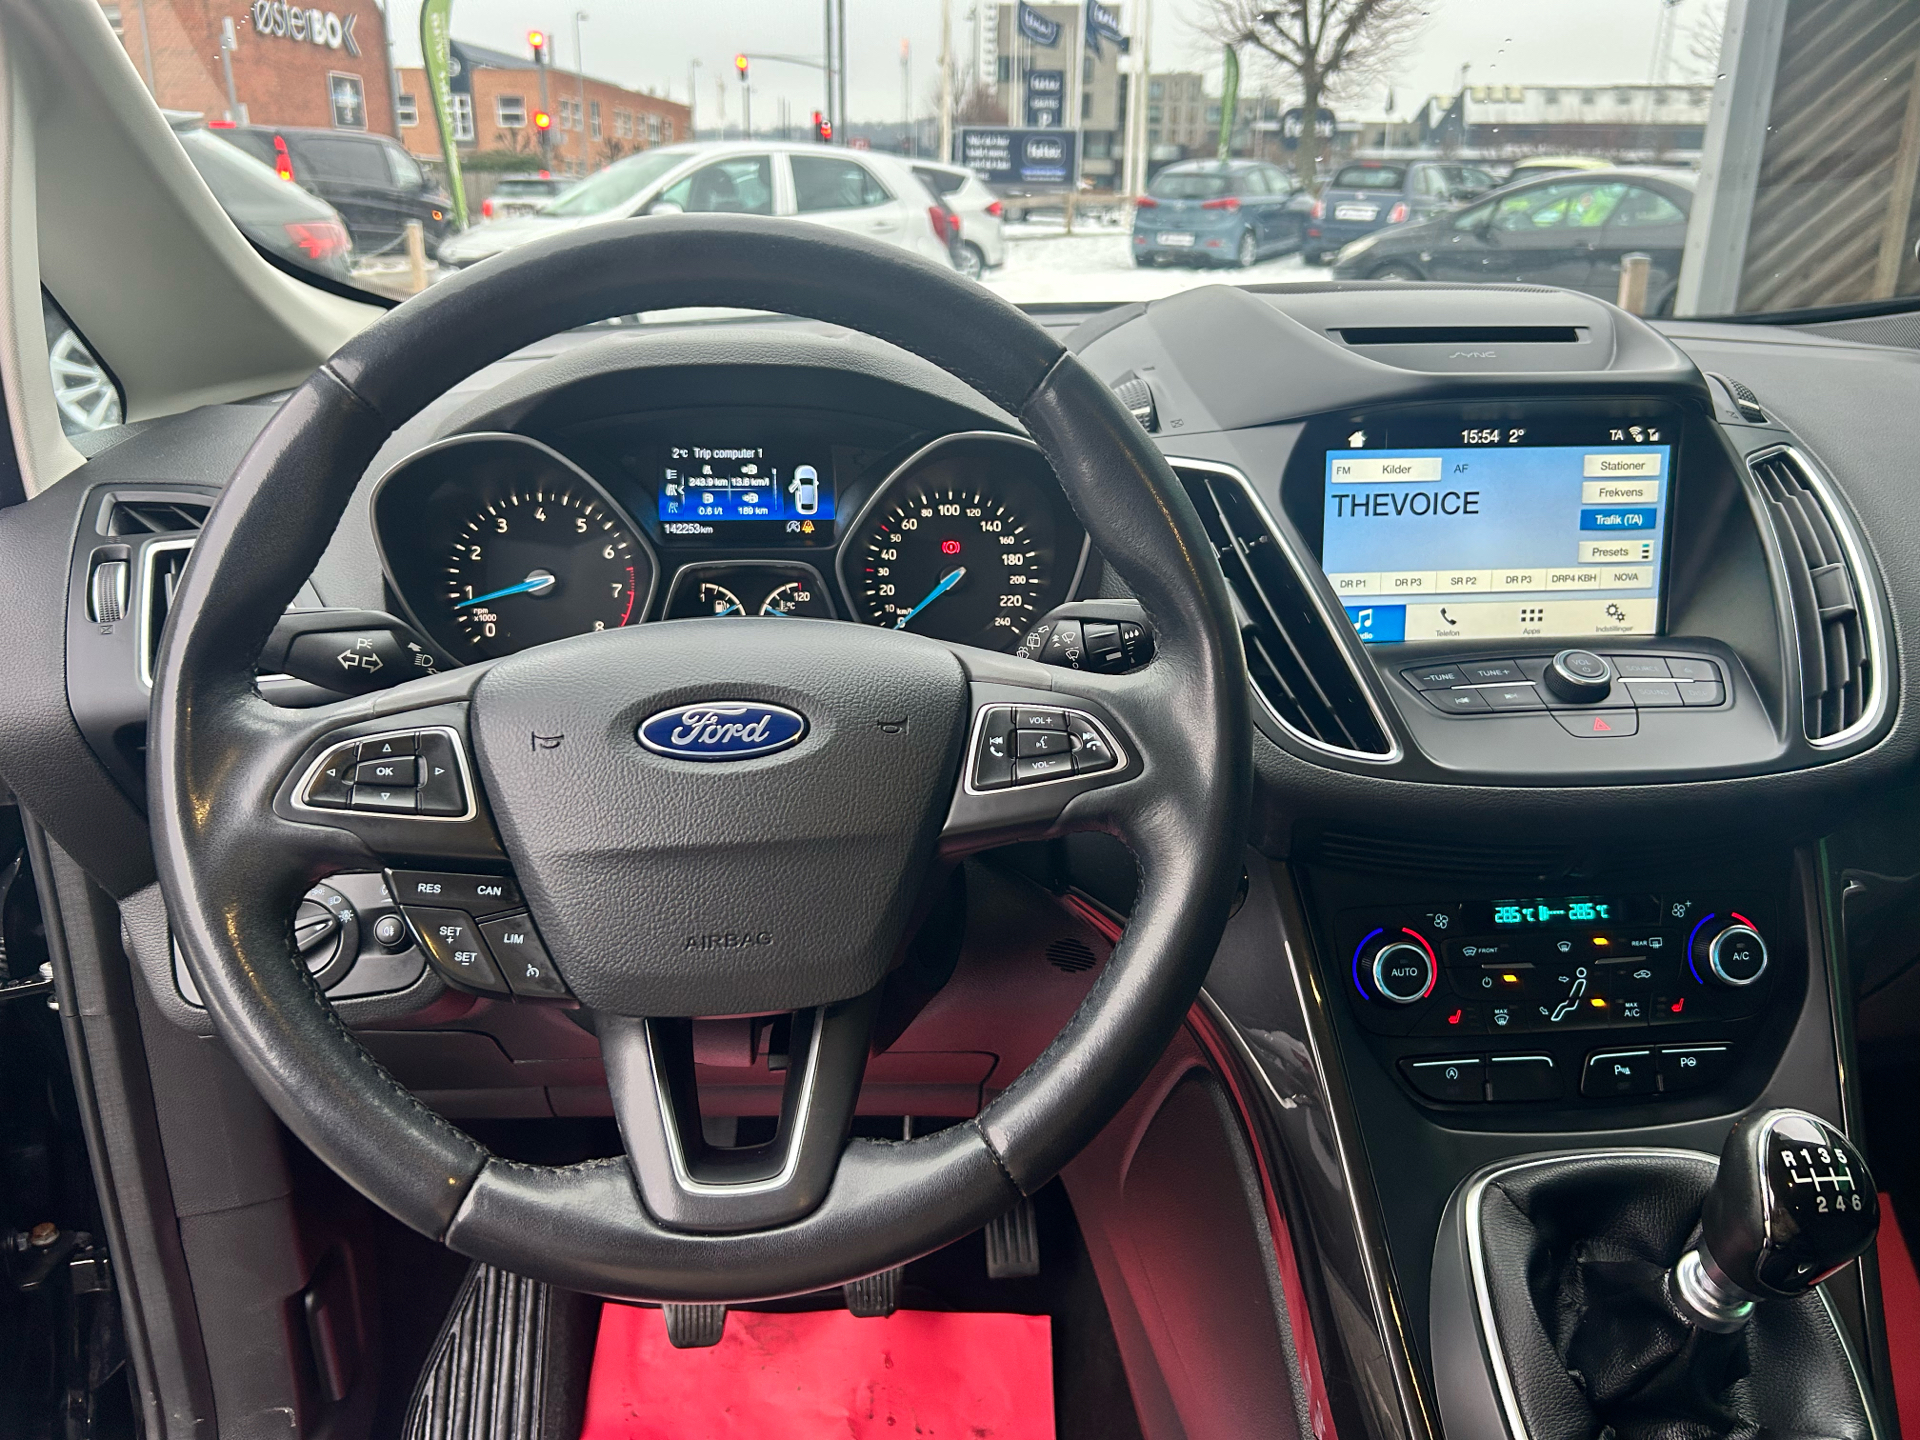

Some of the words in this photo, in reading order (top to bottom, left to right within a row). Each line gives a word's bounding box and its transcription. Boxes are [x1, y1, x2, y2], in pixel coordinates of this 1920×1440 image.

[1461, 429, 1500, 444] 15:54
[1508, 428, 1524, 443] 2°
[1609, 429, 1624, 441] TA
[693, 447, 712, 460] Trip
[713, 449, 755, 460] computer
[757, 448, 763, 458] 1
[1336, 466, 1351, 475] FM
[1382, 464, 1412, 474] Kilder
[1453, 464, 1469, 473] AF
[1600, 460, 1646, 471] Stationer
[689, 477, 713, 487] 243.9
[714, 477, 728, 487] km
[750, 477, 770, 487] km/l
[1598, 487, 1644, 497] Frekvens
[1331, 492, 1480, 517] THEVOICE
[534, 507, 546, 521] 4
[755, 507, 768, 515] km
[921, 508, 933, 517] 80
[938, 504, 960, 516] 100
[966, 508, 982, 517] 120
[901, 518, 918, 531] 60
[1595, 514, 1620, 526] Trafik
[1621, 514, 1642, 526] (TA)
[496, 518, 508, 533] 3
[576, 518, 587, 533] 5
[980, 520, 1002, 532] 140
[890, 534, 902, 542] 50
[999, 536, 1015, 545] 160
[470, 546, 481, 560] 2
[603, 545, 615, 559] 6
[881, 549, 897, 560] 40
[1592, 546, 1629, 557] Presets
[1002, 553, 1023, 565] 180
[877, 568, 890, 576] 30
[1614, 573, 1639, 581] NOVA
[1009, 575, 1026, 584] 200
[1395, 578, 1409, 587] DR
[1410, 578, 1422, 586] P3
[1451, 577, 1464, 586] SR
[1466, 577, 1477, 585] P2
[1505, 575, 1519, 584] DR
[1521, 575, 1532, 583] P3
[1552, 574, 1575, 583] DRP4
[1577, 574, 1596, 582] KBH
[1340, 579, 1354, 589] DR
[1356, 579, 1366, 587] P1
[466, 585, 473, 600] 1
[612, 583, 623, 598] 7
[879, 584, 895, 595] 20
[793, 592, 810, 602] 120
[1000, 595, 1022, 607] 220
[885, 604, 895, 612] 10
[474, 614, 497, 622] x1000
[994, 617, 1011, 626] 240
[484, 622, 495, 637] 0
[671, 708, 771, 745] Ford
[376, 767, 393, 776] OK
[418, 883, 441, 894] RES
[477, 885, 502, 896] CAN
[439, 926, 462, 936] SET
[503, 933, 524, 944] LIM
[684, 932, 774, 950] AIRBAG
[454, 952, 477, 962] SET
[1733, 951, 1750, 961] A/C
[1391, 968, 1418, 976] AUTO
[1624, 1008, 1640, 1017] A/C
[1781, 1150, 1797, 1167] R
[1800, 1148, 1813, 1164] 1
[1818, 1148, 1831, 1163] 3
[1834, 1148, 1848, 1163] 5
[1816, 1196, 1828, 1212] 2
[1836, 1195, 1846, 1212] 4
[1852, 1194, 1862, 1211] 6
